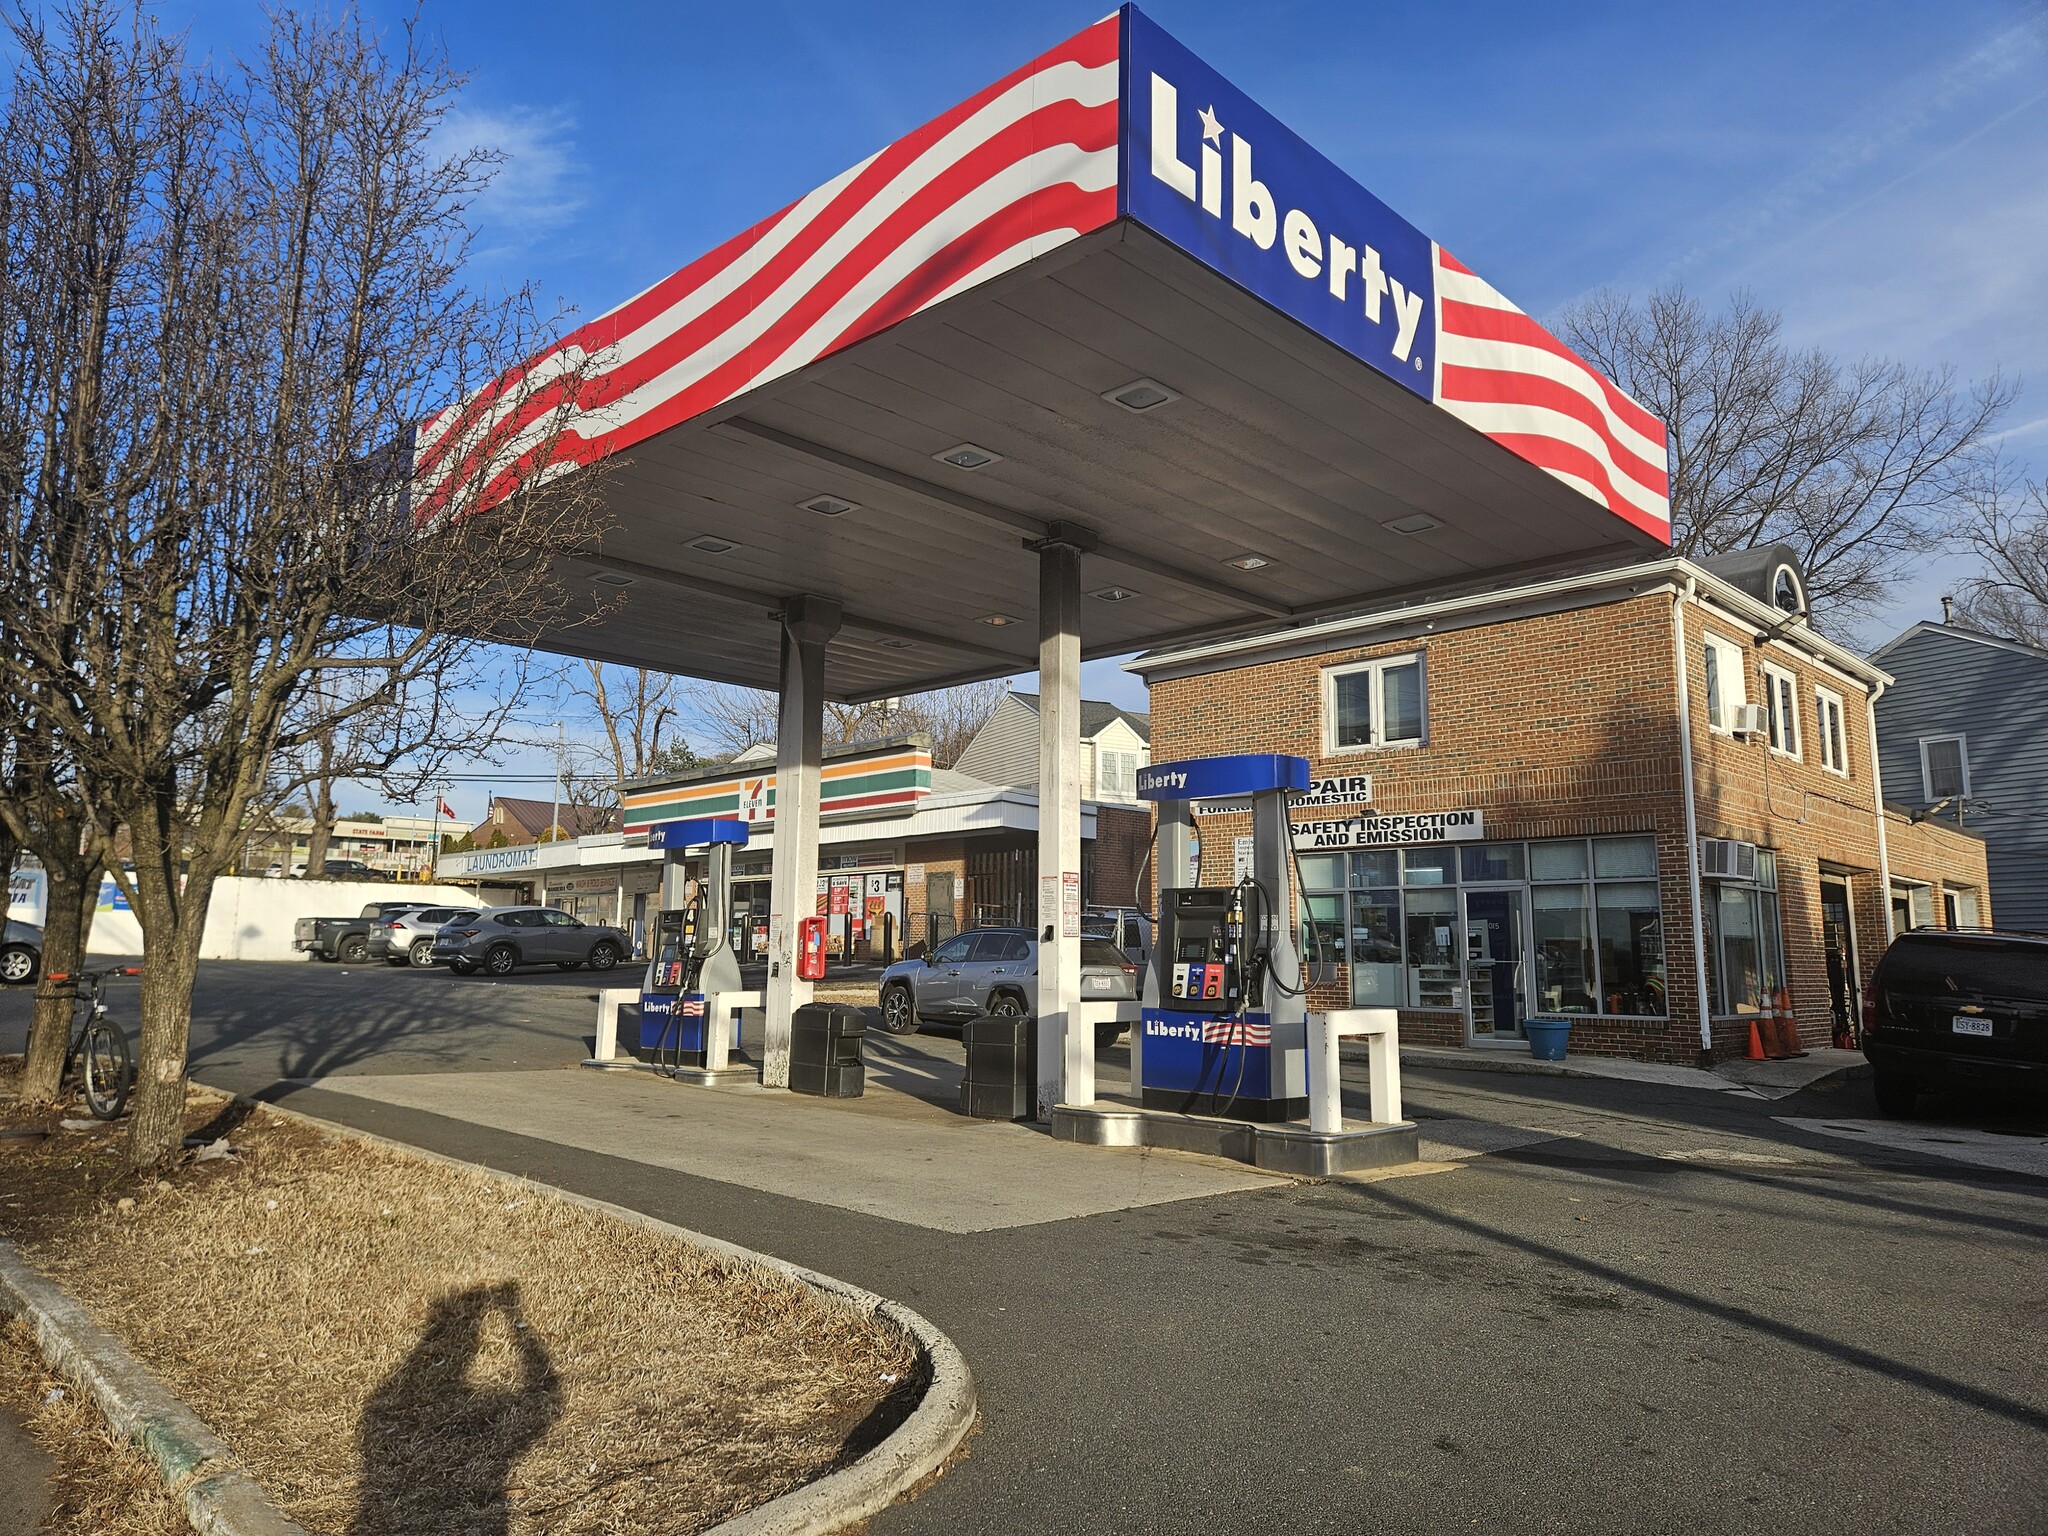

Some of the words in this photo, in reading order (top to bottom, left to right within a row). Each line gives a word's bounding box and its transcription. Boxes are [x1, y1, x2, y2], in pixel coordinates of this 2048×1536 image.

[1151, 71, 1424, 363] Liberty
[1138, 771, 1188, 792] Liberty
[1310, 777, 1367, 794] PAIR
[1291, 819, 1354, 835] SAFETY
[1360, 812, 1475, 831] INSPECTION
[1313, 833, 1350, 847] AND
[1356, 827, 1446, 844] EMISSION
[467, 849, 536, 872] LAUNDROMAT
[644, 1001, 671, 1015] Liberty
[1146, 1020, 1200, 1041] Liberty
